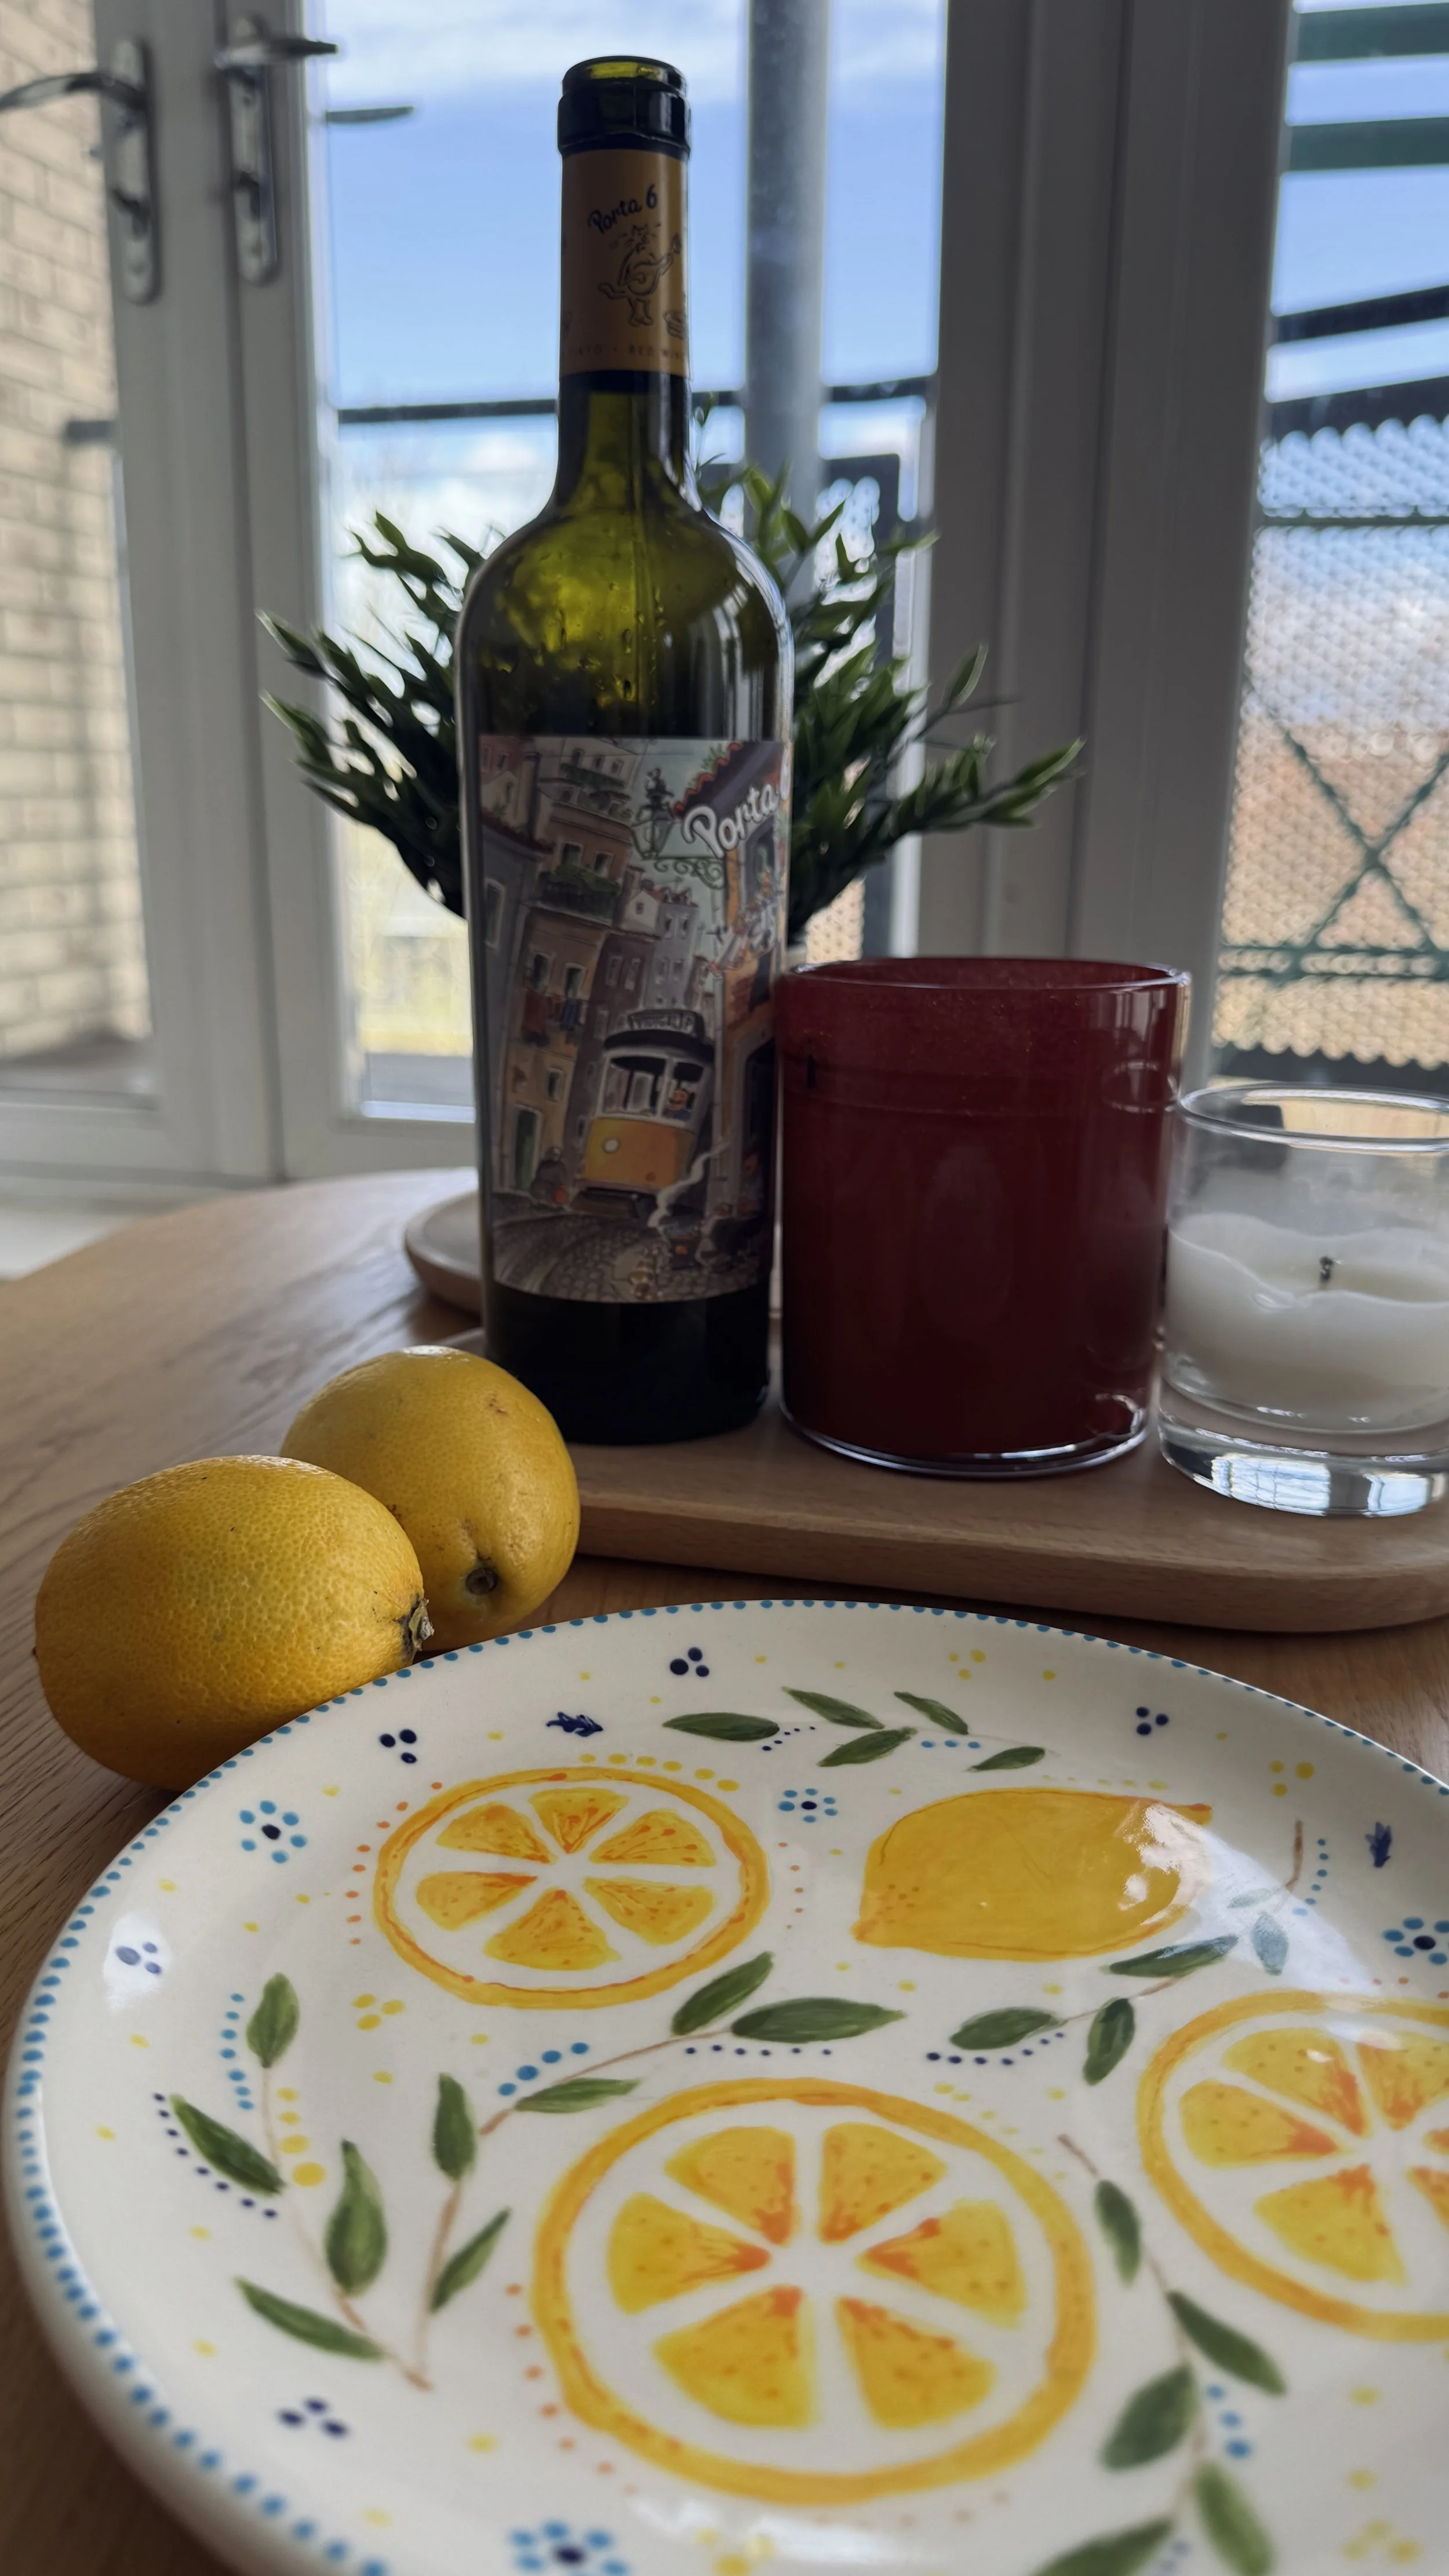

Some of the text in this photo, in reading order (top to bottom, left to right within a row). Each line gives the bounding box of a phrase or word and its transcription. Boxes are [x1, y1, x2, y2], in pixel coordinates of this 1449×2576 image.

[586, 184, 658, 235] Porta 6
[682, 784, 780, 858] Porta
